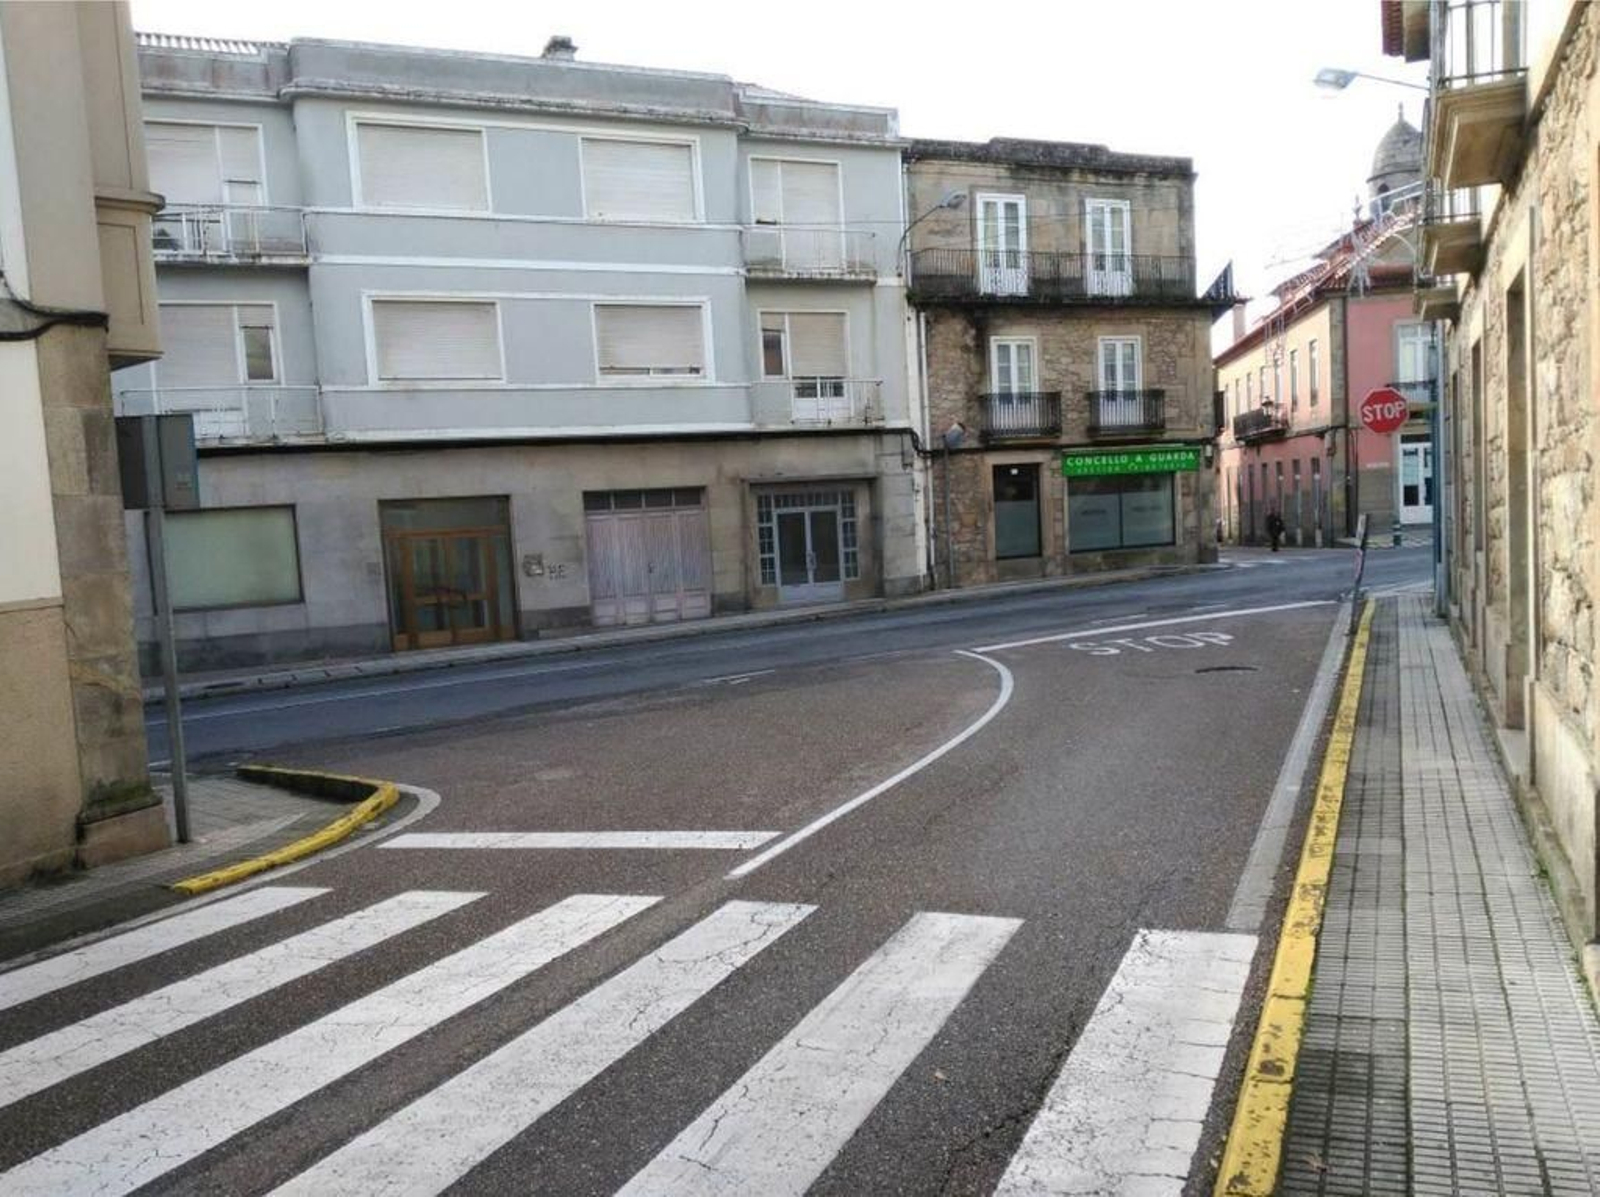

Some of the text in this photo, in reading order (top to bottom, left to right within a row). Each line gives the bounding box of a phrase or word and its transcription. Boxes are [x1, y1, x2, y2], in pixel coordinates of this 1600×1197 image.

[1362, 401, 1405, 423] STOP
[1066, 451, 1195, 467] CONCELLO A GUARDA
[1069, 632, 1235, 656] STOP
